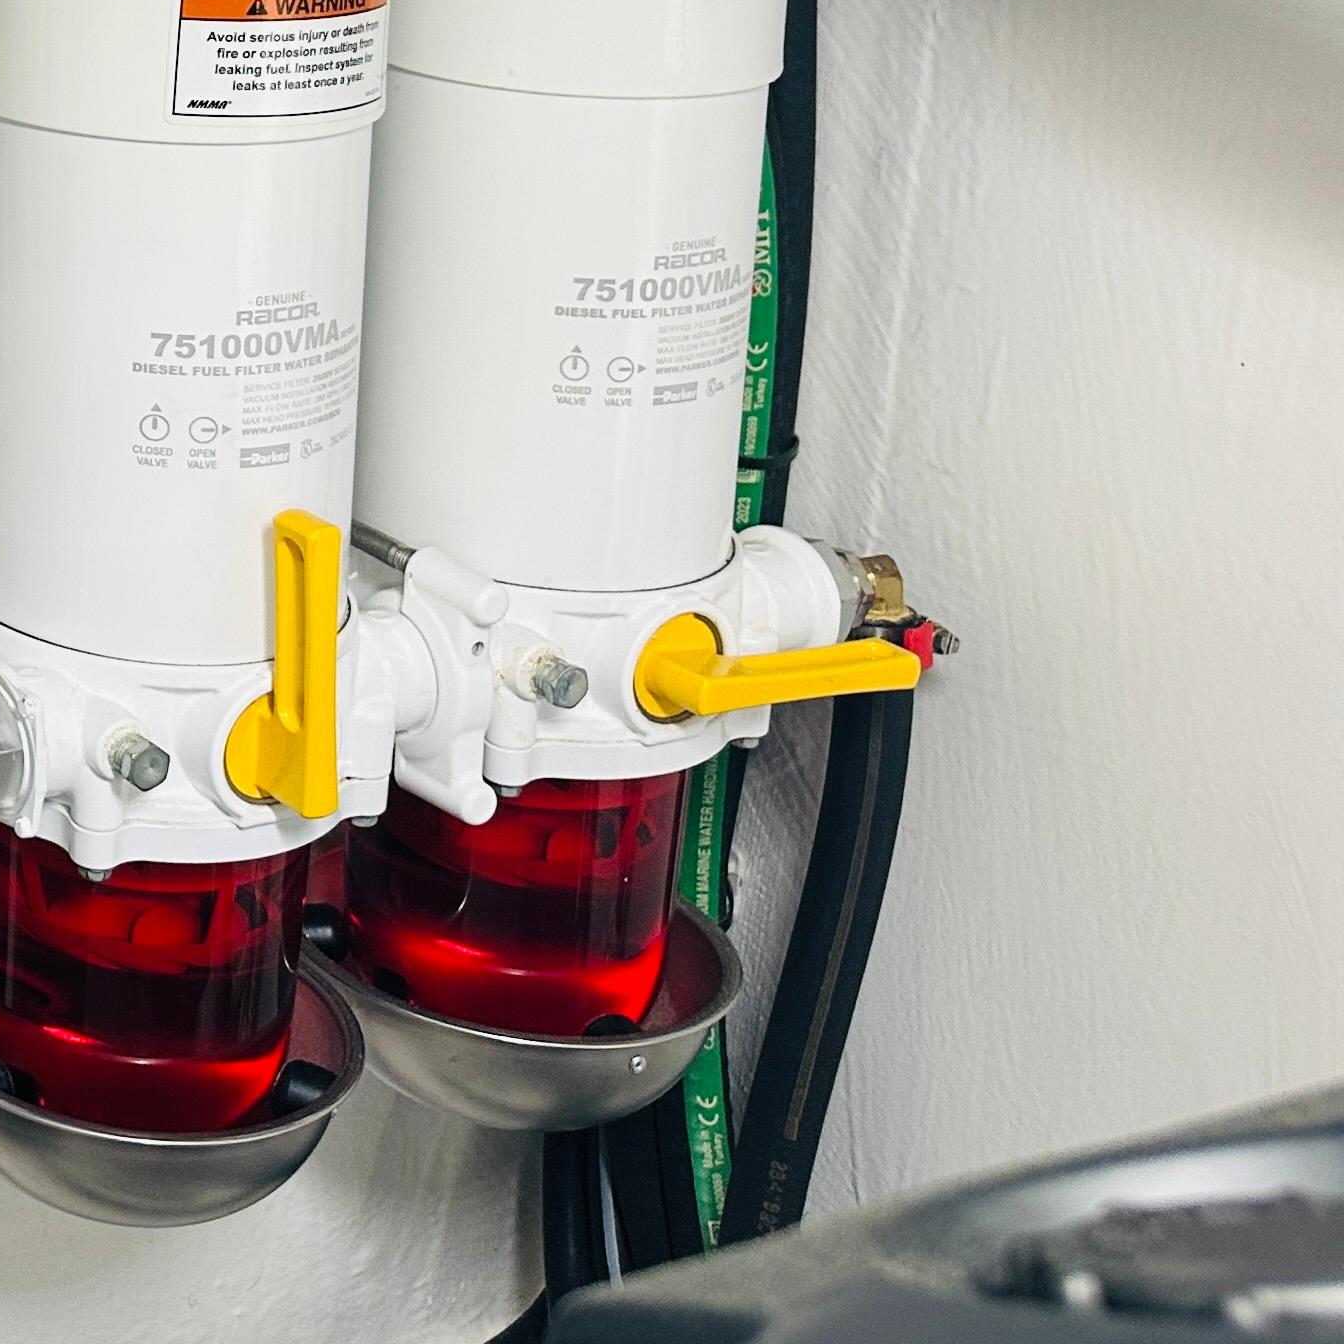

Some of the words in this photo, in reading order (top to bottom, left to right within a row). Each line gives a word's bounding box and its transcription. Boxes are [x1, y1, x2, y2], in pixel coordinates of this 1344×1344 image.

[207, 31, 246, 43] Avoid
[249, 30, 295, 42] serious
[298, 29, 329, 44] injury
[330, 29, 341, 39] or
[342, 24, 365, 37] death
[216, 47, 239, 59] fire
[242, 49, 257, 59] or
[259, 46, 317, 60] explosion
[319, 41, 358, 54] resulting
[214, 63, 262, 77] leaking
[295, 60, 334, 74] Inspect
[334, 56, 364, 71] system
[232, 79, 266, 91] leaks
[269, 80, 281, 91] at
[284, 78, 312, 90] least
[313, 76, 338, 88] once
[672, 236, 717, 253] GENUINE
[572, 263, 742, 303] 751000VMA
[255, 290, 306, 307] GENUINE
[554, 305, 607, 319] DIESEL
[612, 308, 647, 319] FUEL
[651, 305, 692, 319] FILTER
[695, 298, 728, 314] WATER
[150, 319, 339, 359] 751000VMA
[132, 362, 187, 376] DIESEL
[192, 365, 230, 377] FUEL
[234, 362, 281, 377] FILTER
[284, 354, 322, 371] WATER
[746, 341, 769, 372] CE
[552, 384, 592, 396] CLOSED
[606, 387, 632, 396] OPEN
[556, 395, 587, 407] VALVE
[604, 397, 632, 408] VALVE
[132, 444, 173, 457] CLOSED
[189, 448, 216, 458] OPEN
[136, 457, 168, 468] VALVE
[187, 460, 217, 470] VALVE
[698, 805, 714, 846] WATER
[696, 847, 711, 892] MARINE
[696, 1094, 719, 1127] CE
[713, 1131, 724, 1166] Turkey
